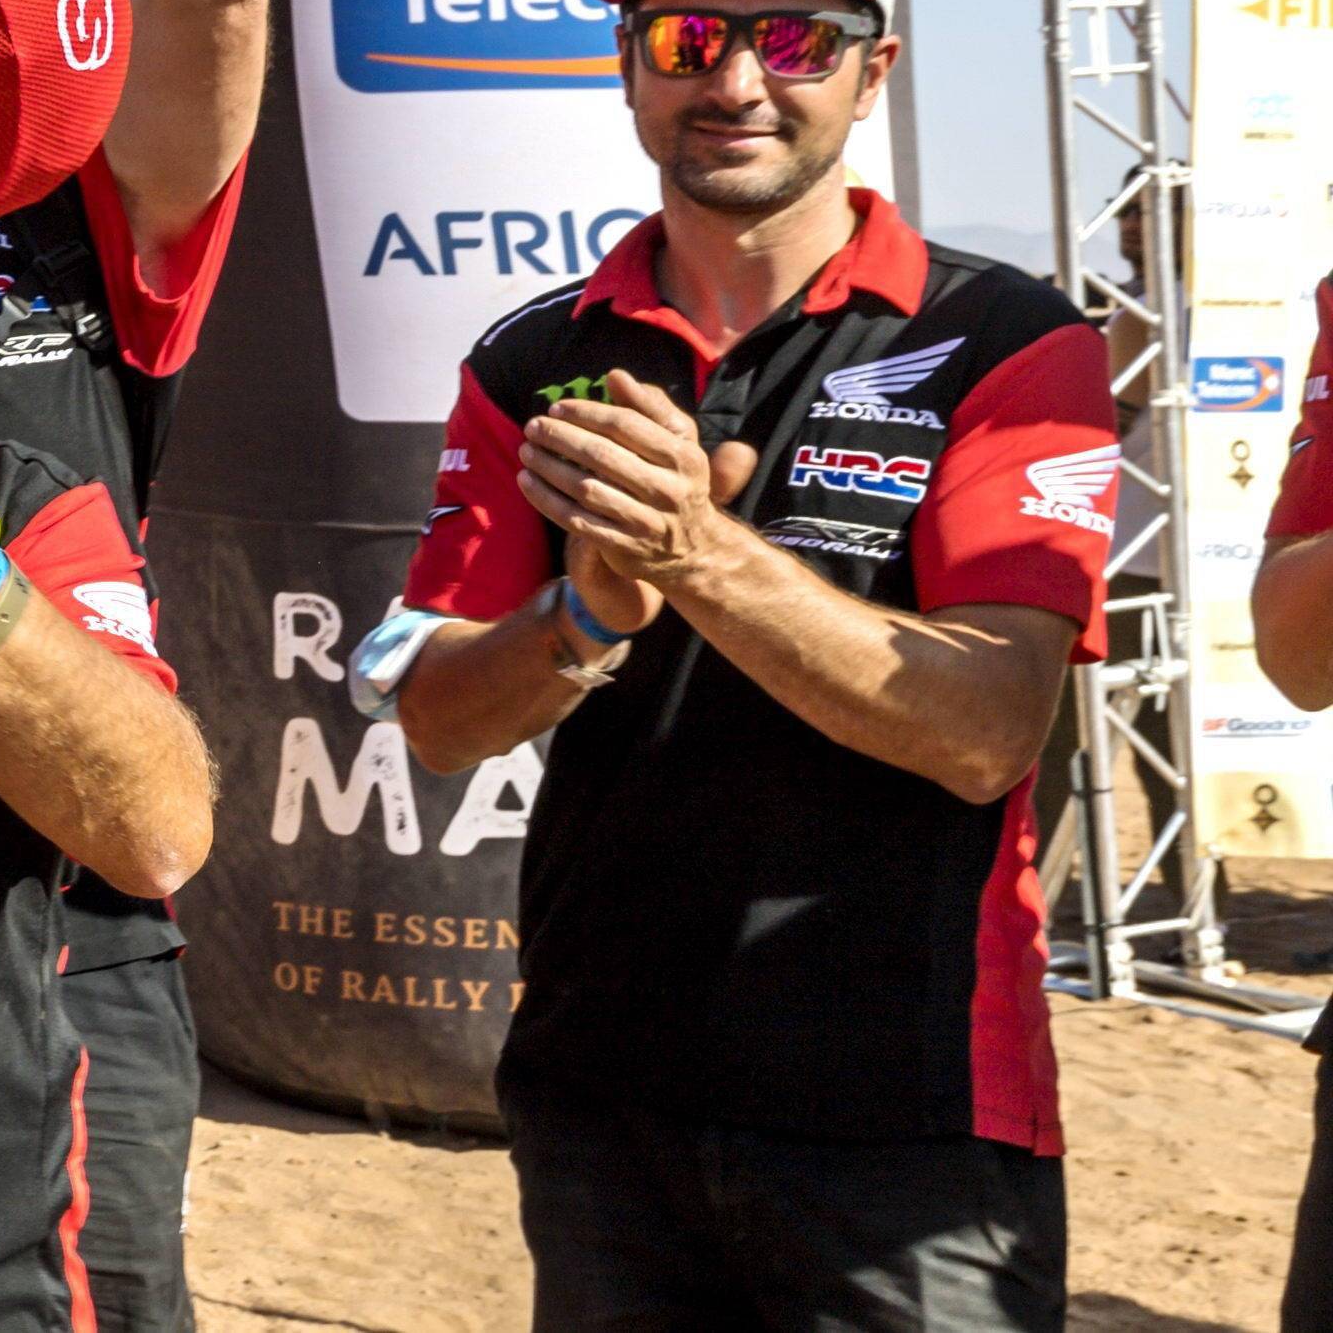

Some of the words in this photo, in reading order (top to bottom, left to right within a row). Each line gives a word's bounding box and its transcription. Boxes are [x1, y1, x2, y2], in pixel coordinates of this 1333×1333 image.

[809, 401, 946, 429] HONDA
[788, 445, 932, 503] HRC
[1019, 495, 1116, 540] HOND
[272, 902, 355, 939] THE
[274, 963, 324, 994] OF
[339, 971, 490, 1012] RALLY
